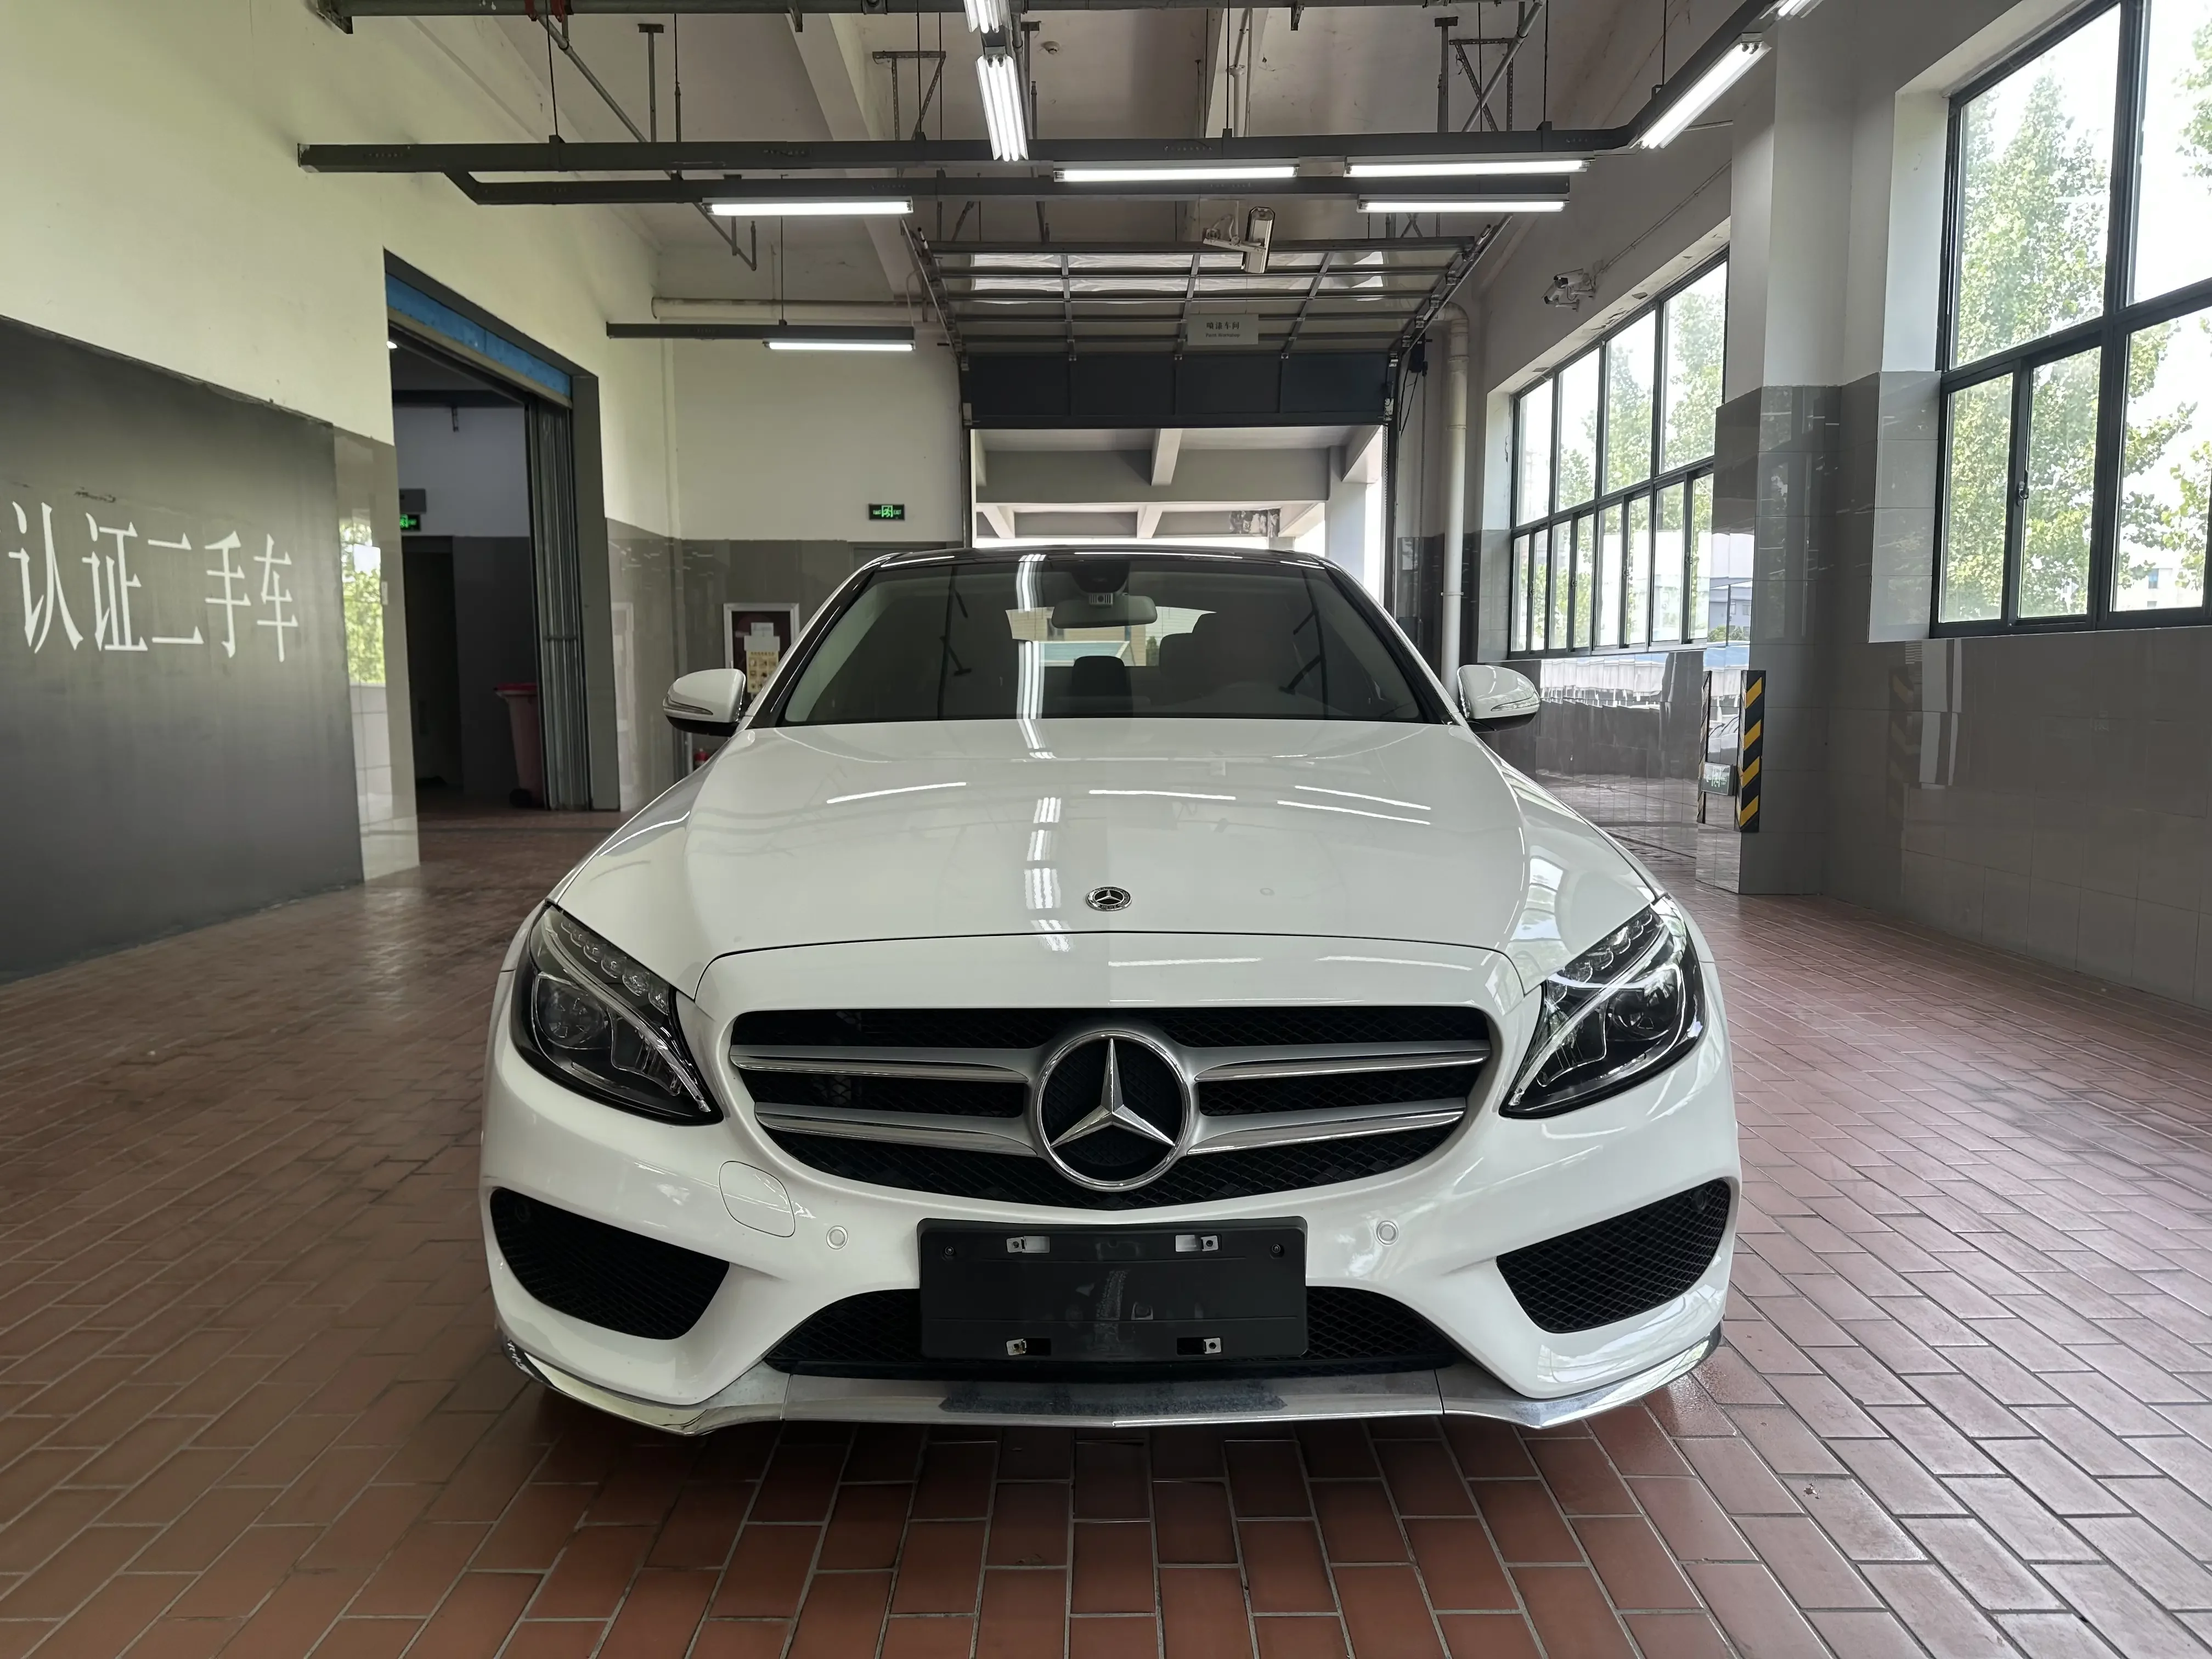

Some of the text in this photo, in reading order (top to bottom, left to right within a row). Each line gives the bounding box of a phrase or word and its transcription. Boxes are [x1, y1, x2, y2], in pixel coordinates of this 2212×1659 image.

[8, 501, 298, 662] 认证二手车
